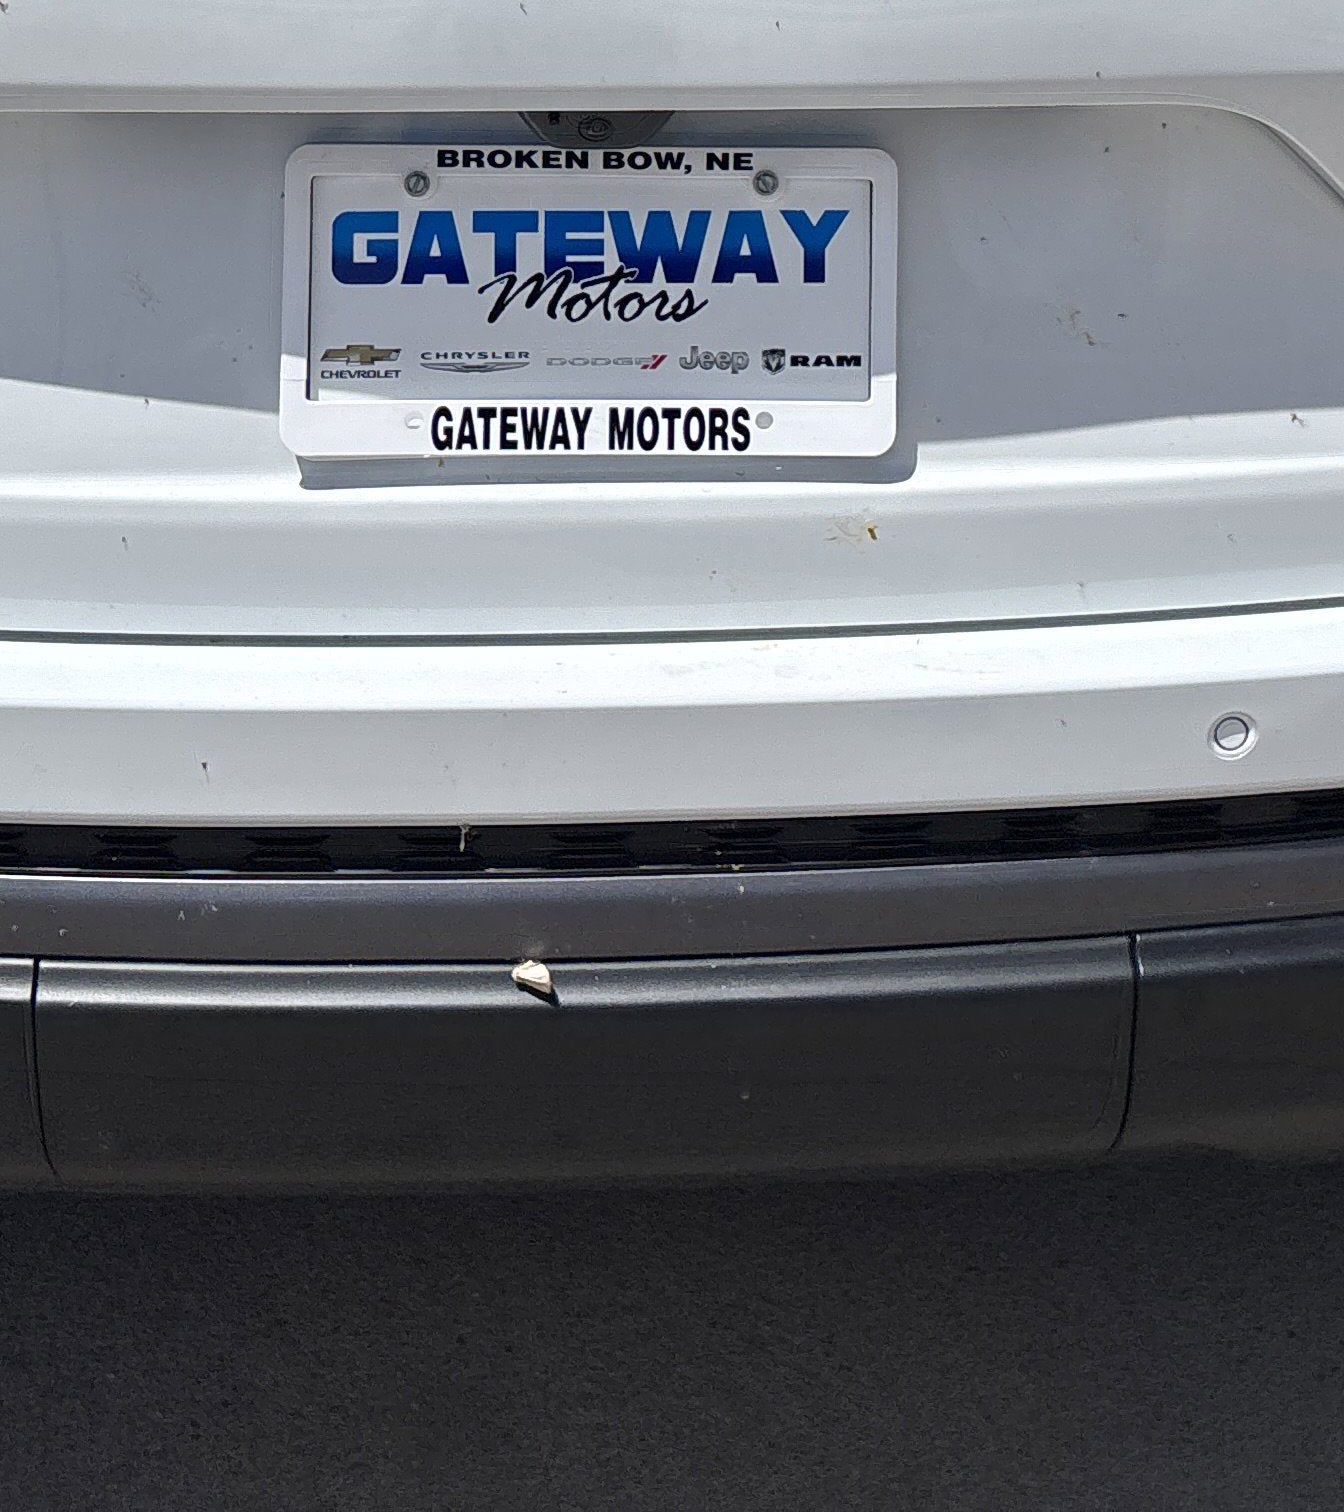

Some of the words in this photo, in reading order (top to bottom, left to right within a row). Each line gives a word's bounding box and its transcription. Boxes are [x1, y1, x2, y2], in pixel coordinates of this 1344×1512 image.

[436, 149, 590, 170] BROKEN
[602, 150, 692, 174] BOW,
[705, 152, 755, 172] NE
[331, 209, 850, 286] GATEWAY
[479, 264, 709, 325] Motors
[420, 350, 530, 360] CHRYSLER
[546, 356, 648, 368] DODGE
[679, 346, 750, 375] Jeep
[790, 354, 862, 369] RAM
[320, 369, 402, 379] CHEVROLET
[431, 406, 593, 452] GATEWAY
[608, 407, 752, 453] MOTORS
